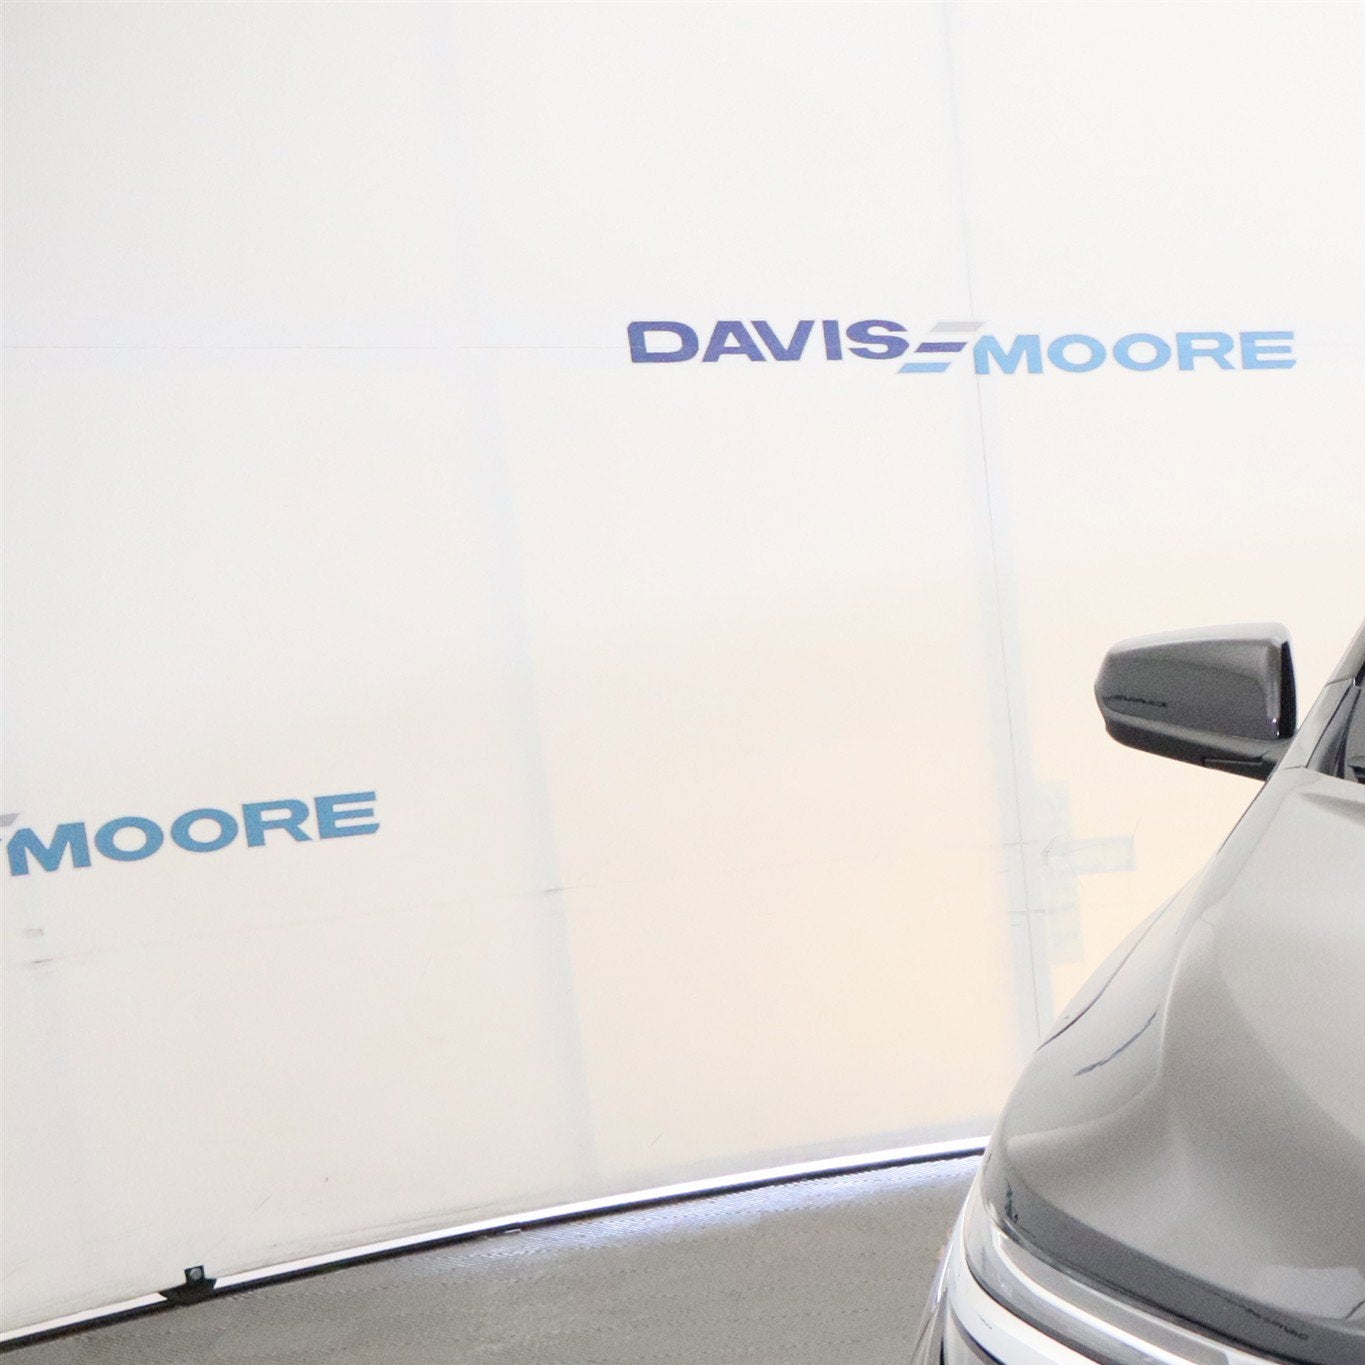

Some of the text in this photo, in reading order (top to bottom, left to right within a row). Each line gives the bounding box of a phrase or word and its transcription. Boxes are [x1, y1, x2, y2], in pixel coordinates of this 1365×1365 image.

[627, 318, 1297, 375] DAVIS MOORE
[5, 790, 381, 877] MOORE
